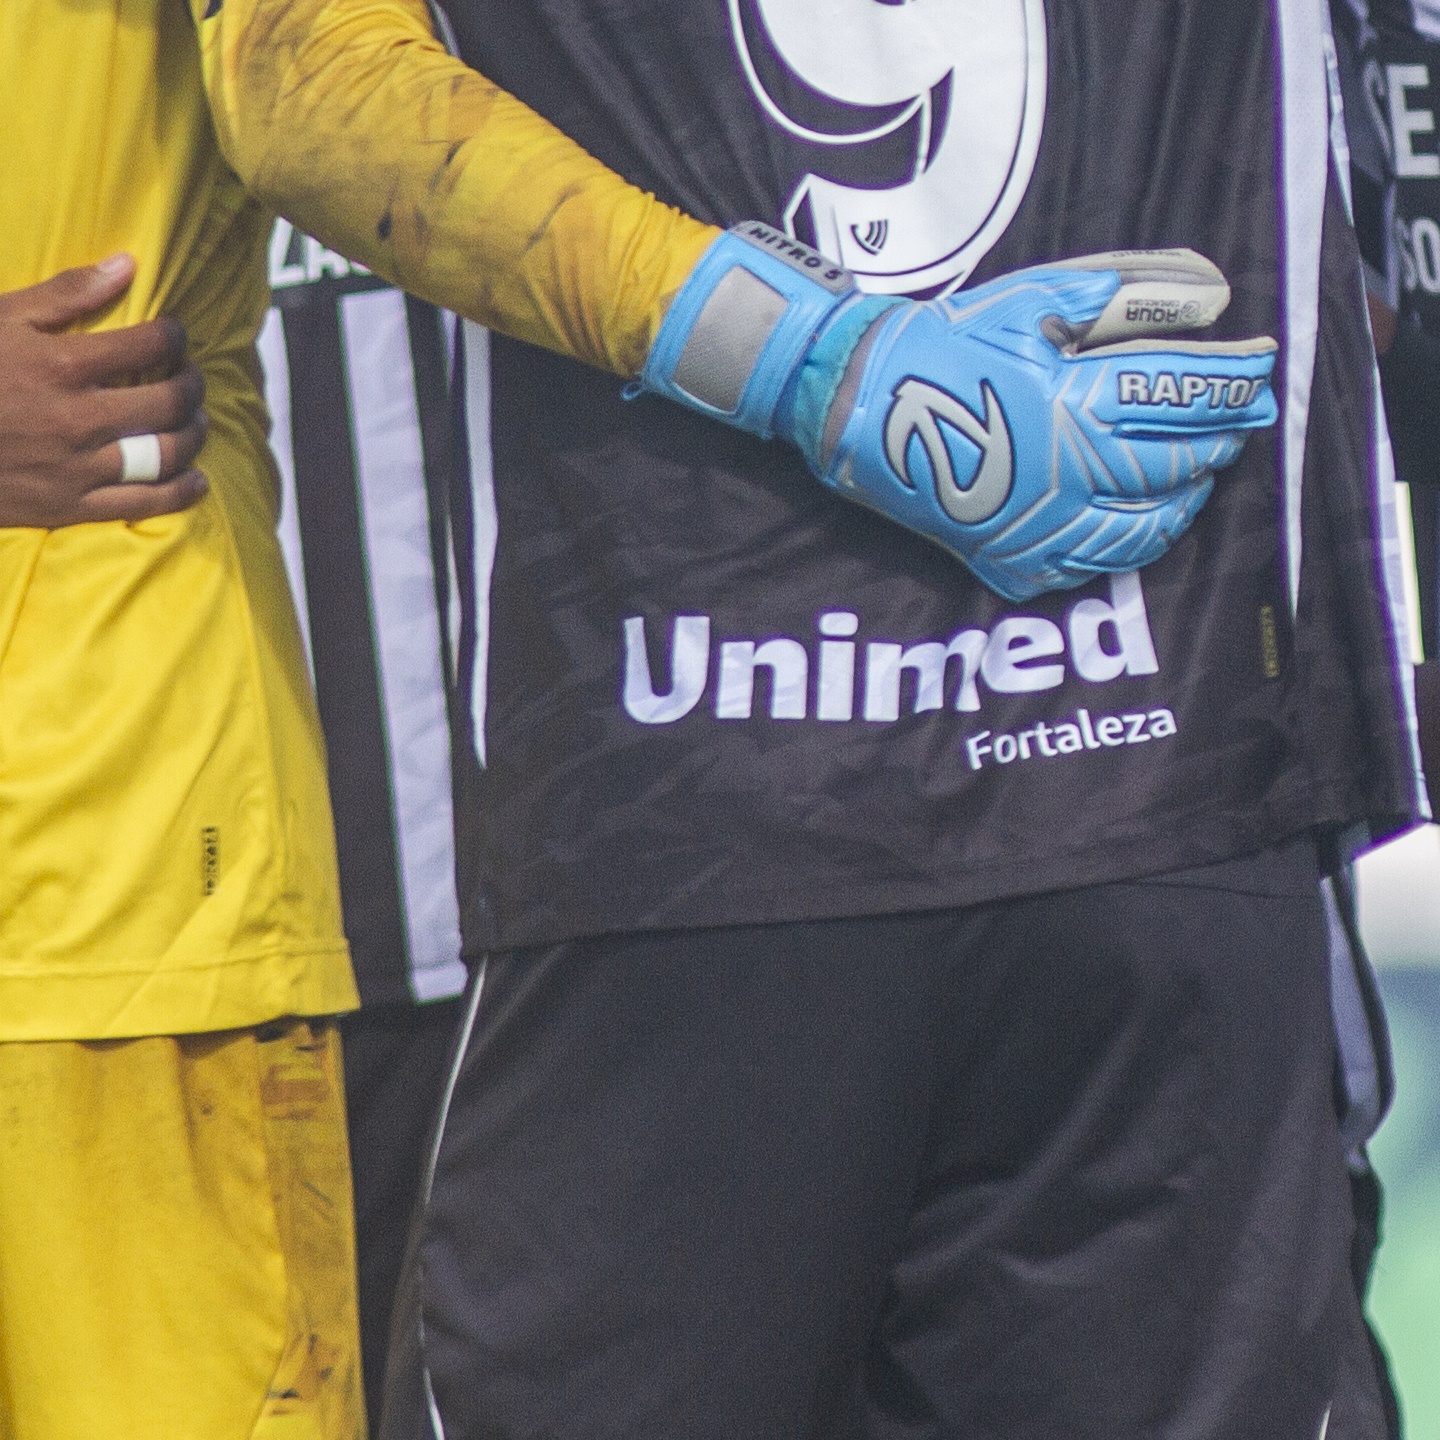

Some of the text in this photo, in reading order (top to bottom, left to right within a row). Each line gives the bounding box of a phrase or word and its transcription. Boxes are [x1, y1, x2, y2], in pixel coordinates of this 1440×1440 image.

[748, 227, 821, 268] NITRO
[1125, 307, 1179, 324] AQUA
[623, 565, 1159, 724] Unimed
[966, 708, 1178, 771] Fortaleza
